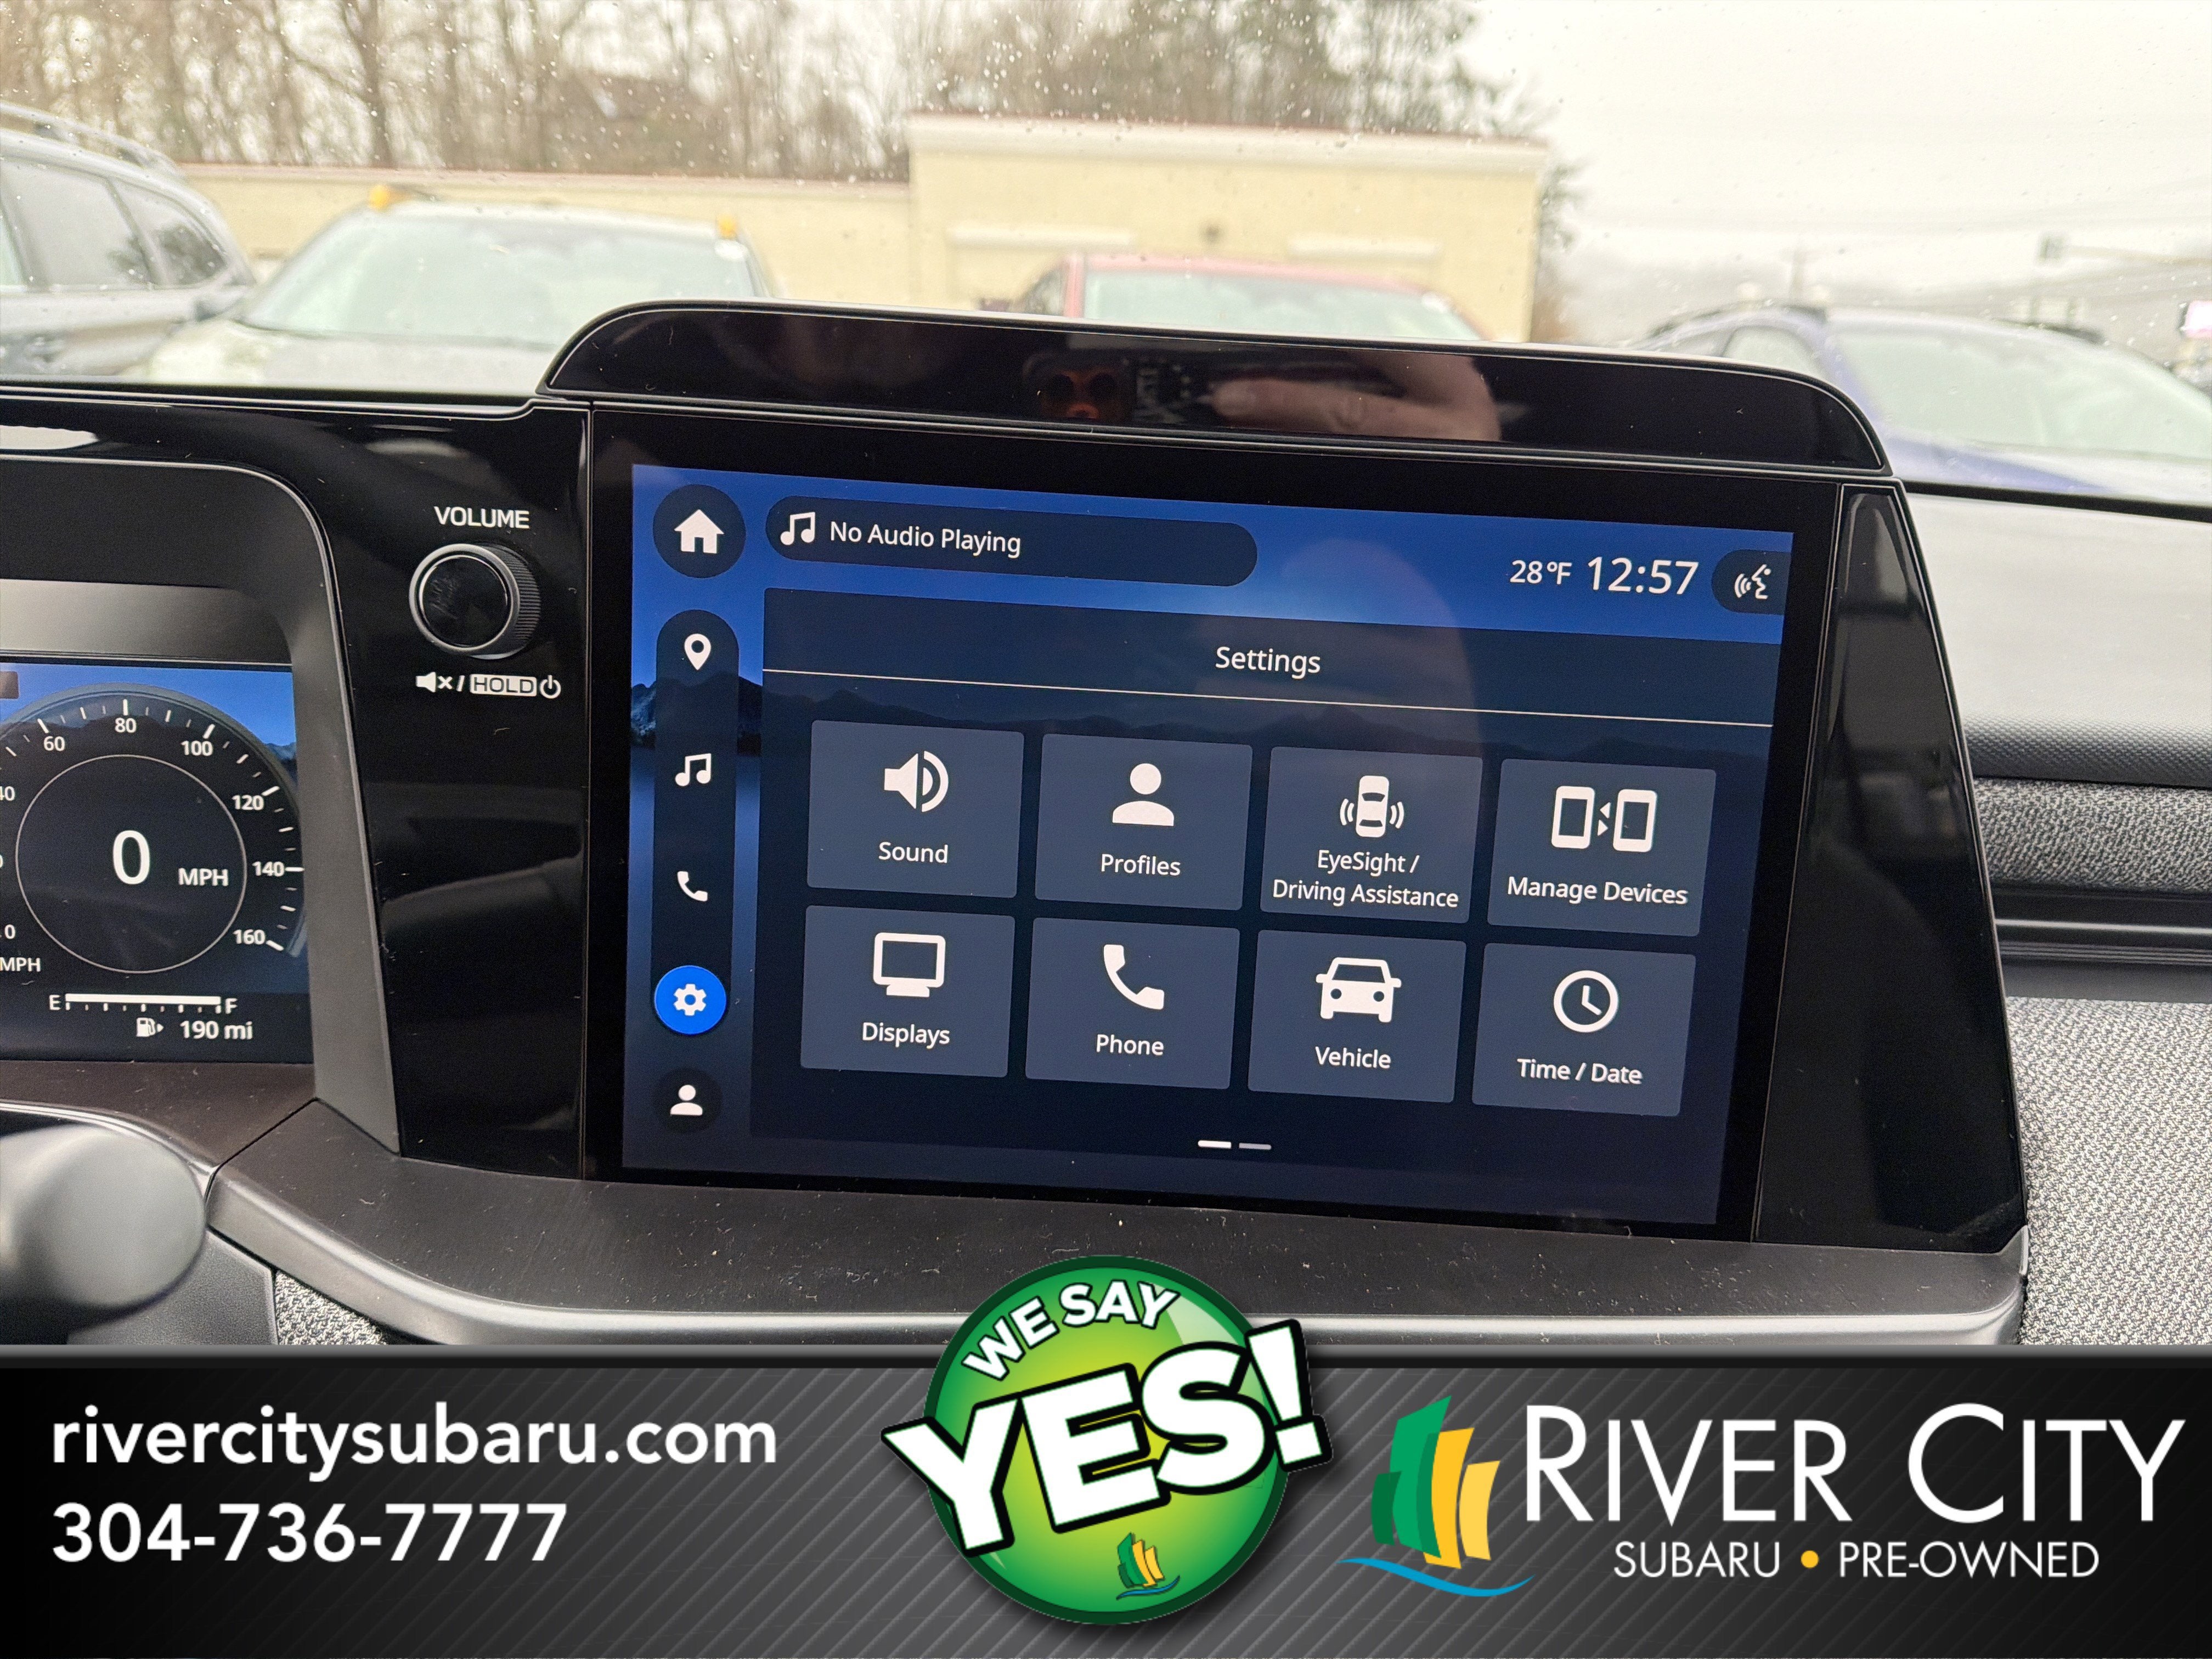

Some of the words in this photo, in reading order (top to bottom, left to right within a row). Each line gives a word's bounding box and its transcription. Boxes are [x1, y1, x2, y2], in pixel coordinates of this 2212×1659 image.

[433, 506, 529, 529] VOLUME
[831, 521, 862, 542] No
[867, 524, 934, 547] Audio
[941, 528, 1021, 558] Playing
[1588, 556, 1699, 595] 12:57
[1215, 646, 1321, 679] Settings
[473, 678, 534, 693] HOLD
[115, 717, 137, 733] 80
[43, 736, 65, 752] 60
[181, 740, 213, 757] 100
[232, 794, 264, 810] 120
[112, 830, 150, 885] 0
[878, 842, 949, 864] Sound
[1318, 849, 1405, 877] EyeSight
[252, 861, 284, 877] 140
[1101, 854, 1181, 876] Profiles
[178, 867, 229, 887] MPH
[1273, 879, 1345, 907] Driving
[1350, 884, 1459, 907] Assistance
[1508, 876, 1598, 904] Manage
[1604, 882, 1688, 905] Devices
[4, 924, 16, 939] 0
[233, 929, 266, 945] 160
[0, 957, 41, 972] MPH
[49, 994, 61, 1011] E
[225, 998, 238, 1014] F
[180, 1020, 219, 1040] 190
[224, 1021, 252, 1040] mi
[862, 1022, 950, 1049] Displays
[1096, 1034, 1164, 1056] Phone
[1315, 1046, 1391, 1069] Vehicle
[1517, 1058, 1571, 1080] Time
[1591, 1063, 1643, 1085] Date
